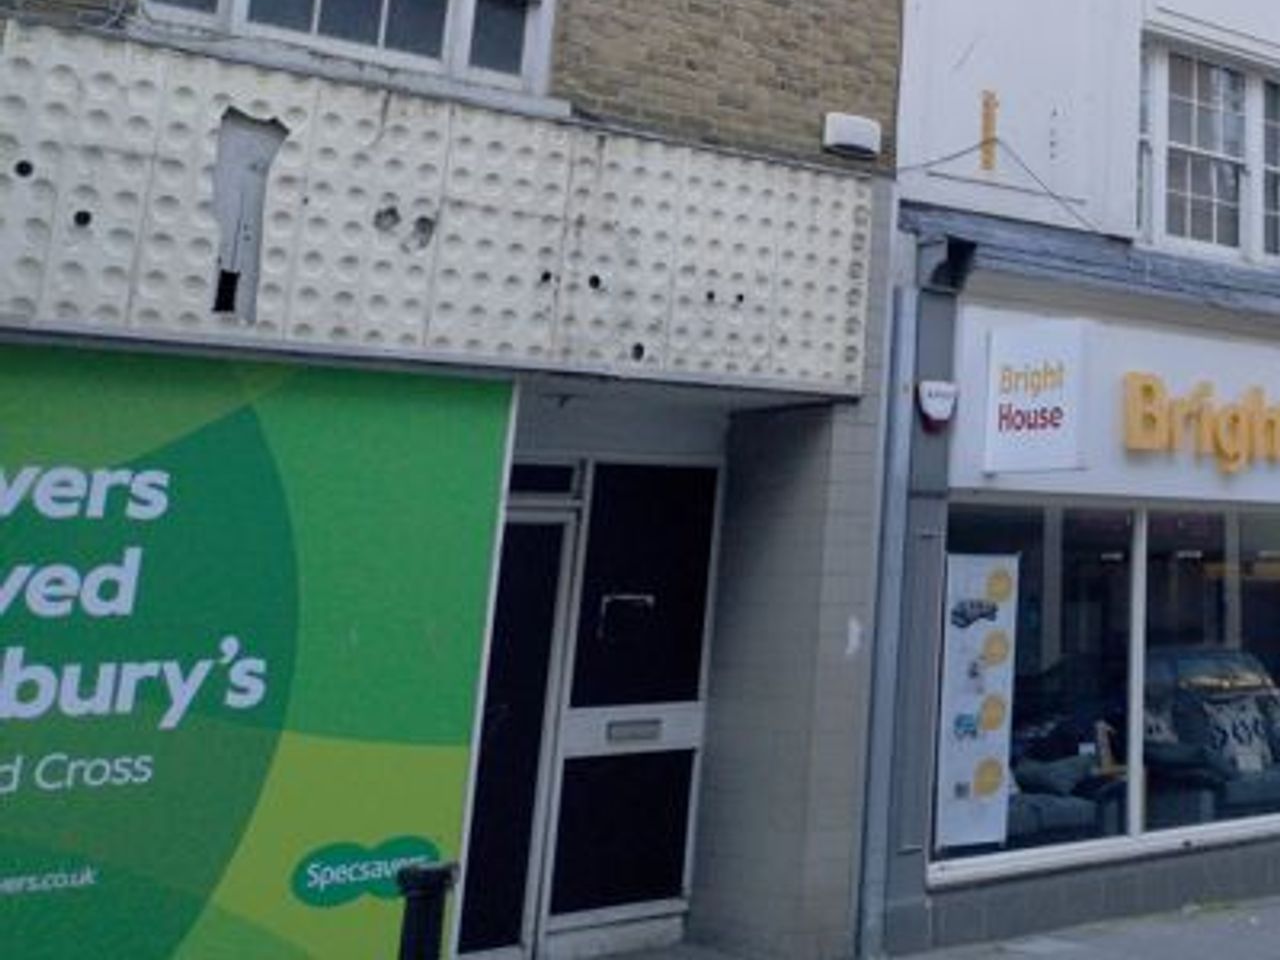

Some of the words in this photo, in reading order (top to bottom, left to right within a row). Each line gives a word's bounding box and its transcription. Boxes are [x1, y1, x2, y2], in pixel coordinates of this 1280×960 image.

[1001, 359, 1065, 398] Bright
[998, 403, 1064, 432] House
[35, 752, 153, 789] Cross
